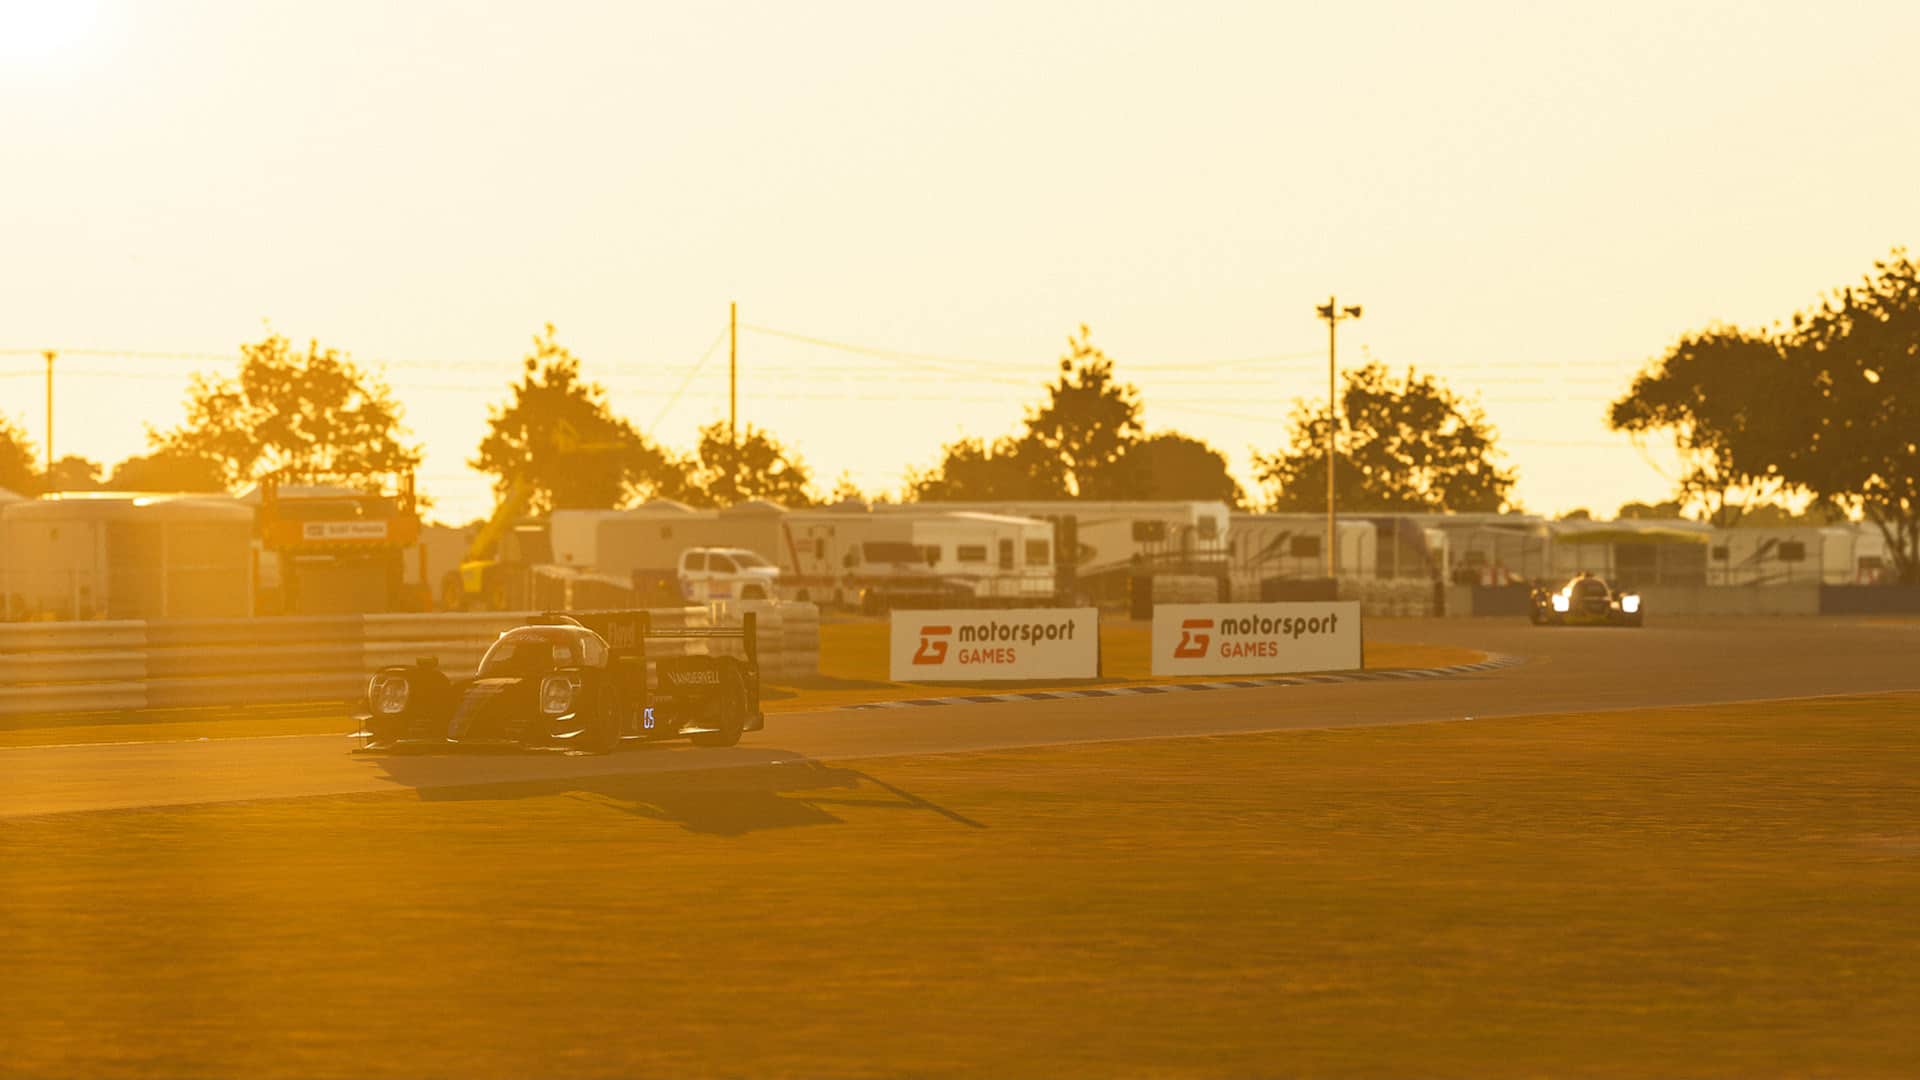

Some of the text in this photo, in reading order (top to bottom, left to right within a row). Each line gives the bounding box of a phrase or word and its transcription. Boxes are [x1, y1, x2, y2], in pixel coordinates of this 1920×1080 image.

[958, 618, 1076, 646] motorsport
[1220, 613, 1338, 640] motorsport
[958, 648, 1016, 665] GAMES
[1220, 641, 1278, 658] GAMES
[643, 707, 655, 729] 05
